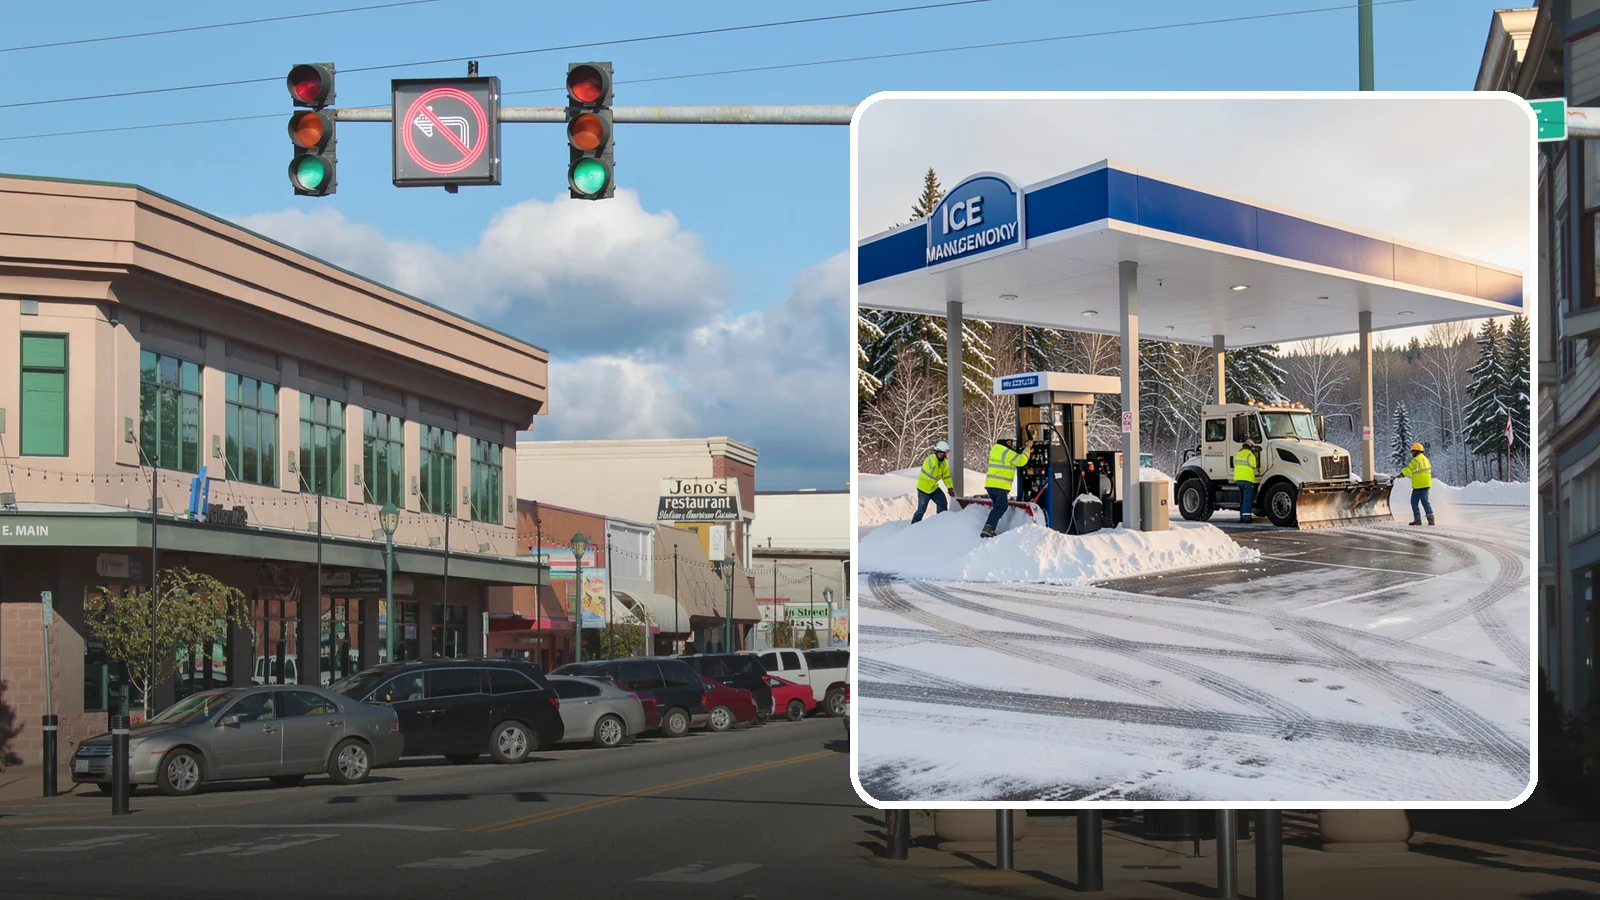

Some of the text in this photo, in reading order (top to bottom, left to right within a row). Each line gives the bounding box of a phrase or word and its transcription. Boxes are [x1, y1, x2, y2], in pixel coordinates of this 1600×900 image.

[942, 196, 982, 235] ICE
[670, 480, 727, 494] Jeno's
[665, 496, 731, 509] restaurant
[658, 510, 682, 520] Italian
[686, 510, 714, 519] American
[714, 510, 738, 519] Cuisine
[2, 525, 49, 536] E. MAIN
[797, 607, 829, 617] Street
